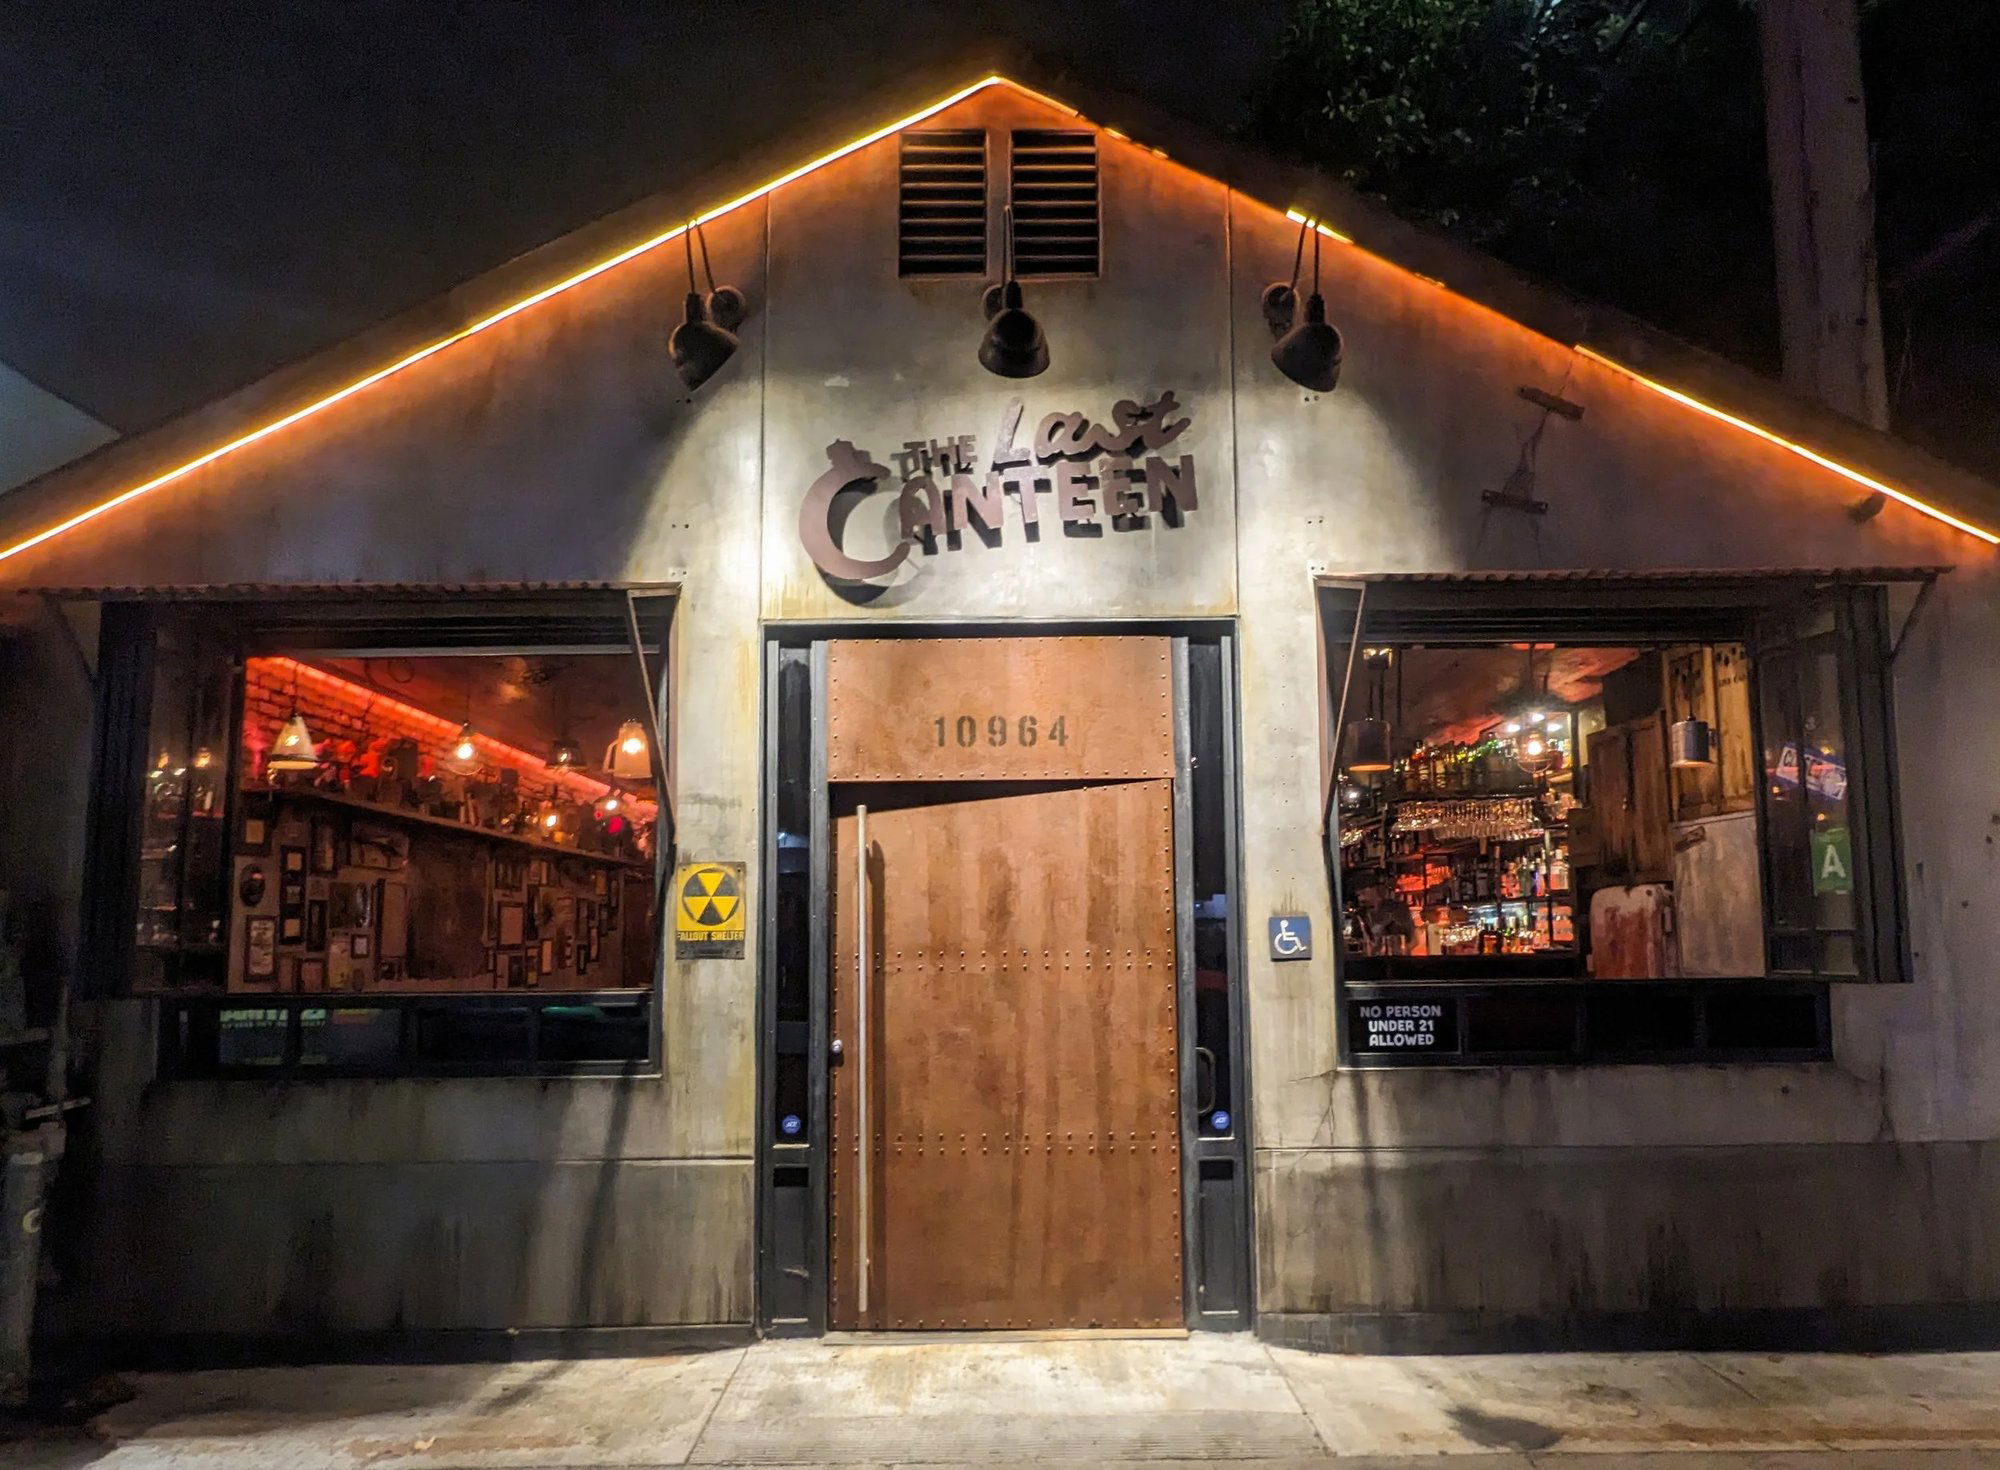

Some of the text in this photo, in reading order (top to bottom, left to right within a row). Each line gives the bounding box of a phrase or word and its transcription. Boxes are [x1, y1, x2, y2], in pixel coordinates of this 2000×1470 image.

[902, 389, 1192, 475] THE Last
[799, 438, 1199, 580] CANTEEN
[934, 714, 1069, 748] 10964
[1821, 844, 1846, 879] A
[1360, 1005, 1441, 1018] NO PERSON
[1368, 1020, 1434, 1032] UNDER 21
[1368, 1034, 1434, 1047] ALLOWED
